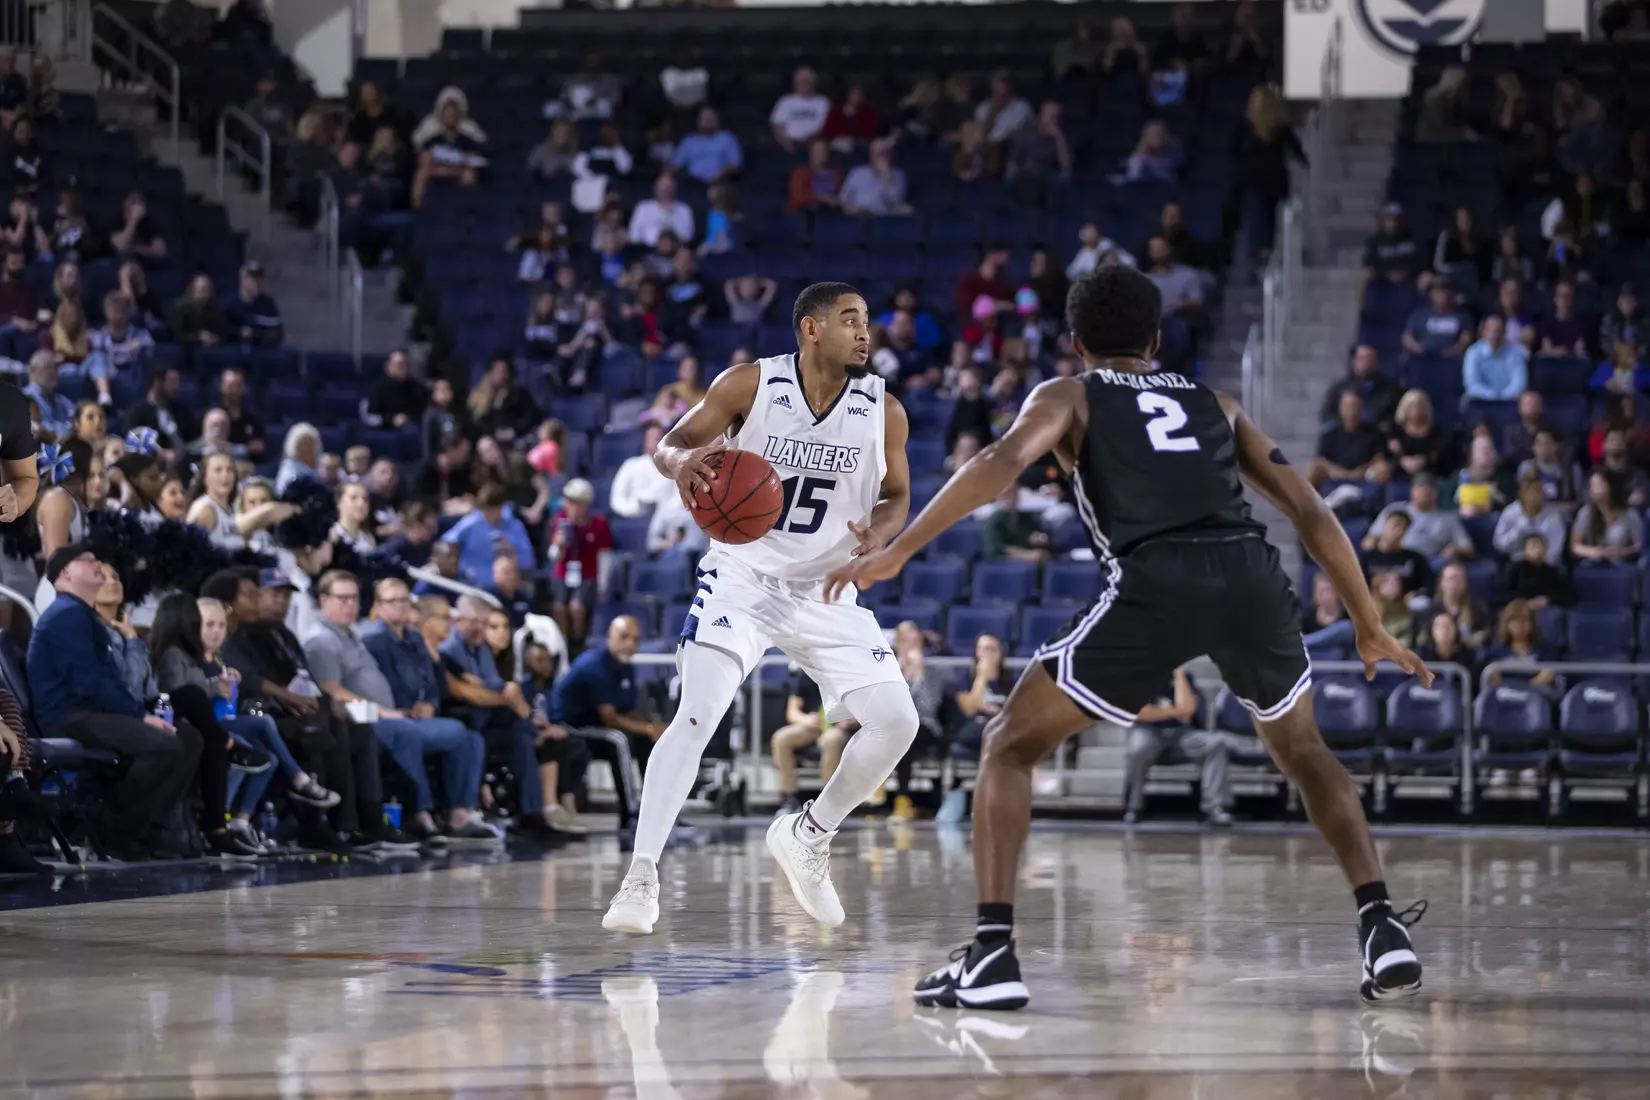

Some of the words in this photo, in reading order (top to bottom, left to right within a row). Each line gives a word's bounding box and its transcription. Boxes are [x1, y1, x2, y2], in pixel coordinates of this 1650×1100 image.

[847, 406, 869, 417] WAC
[1136, 391, 1201, 451] 2
[763, 435, 860, 473] LANCERS
[772, 475, 837, 534] 15
